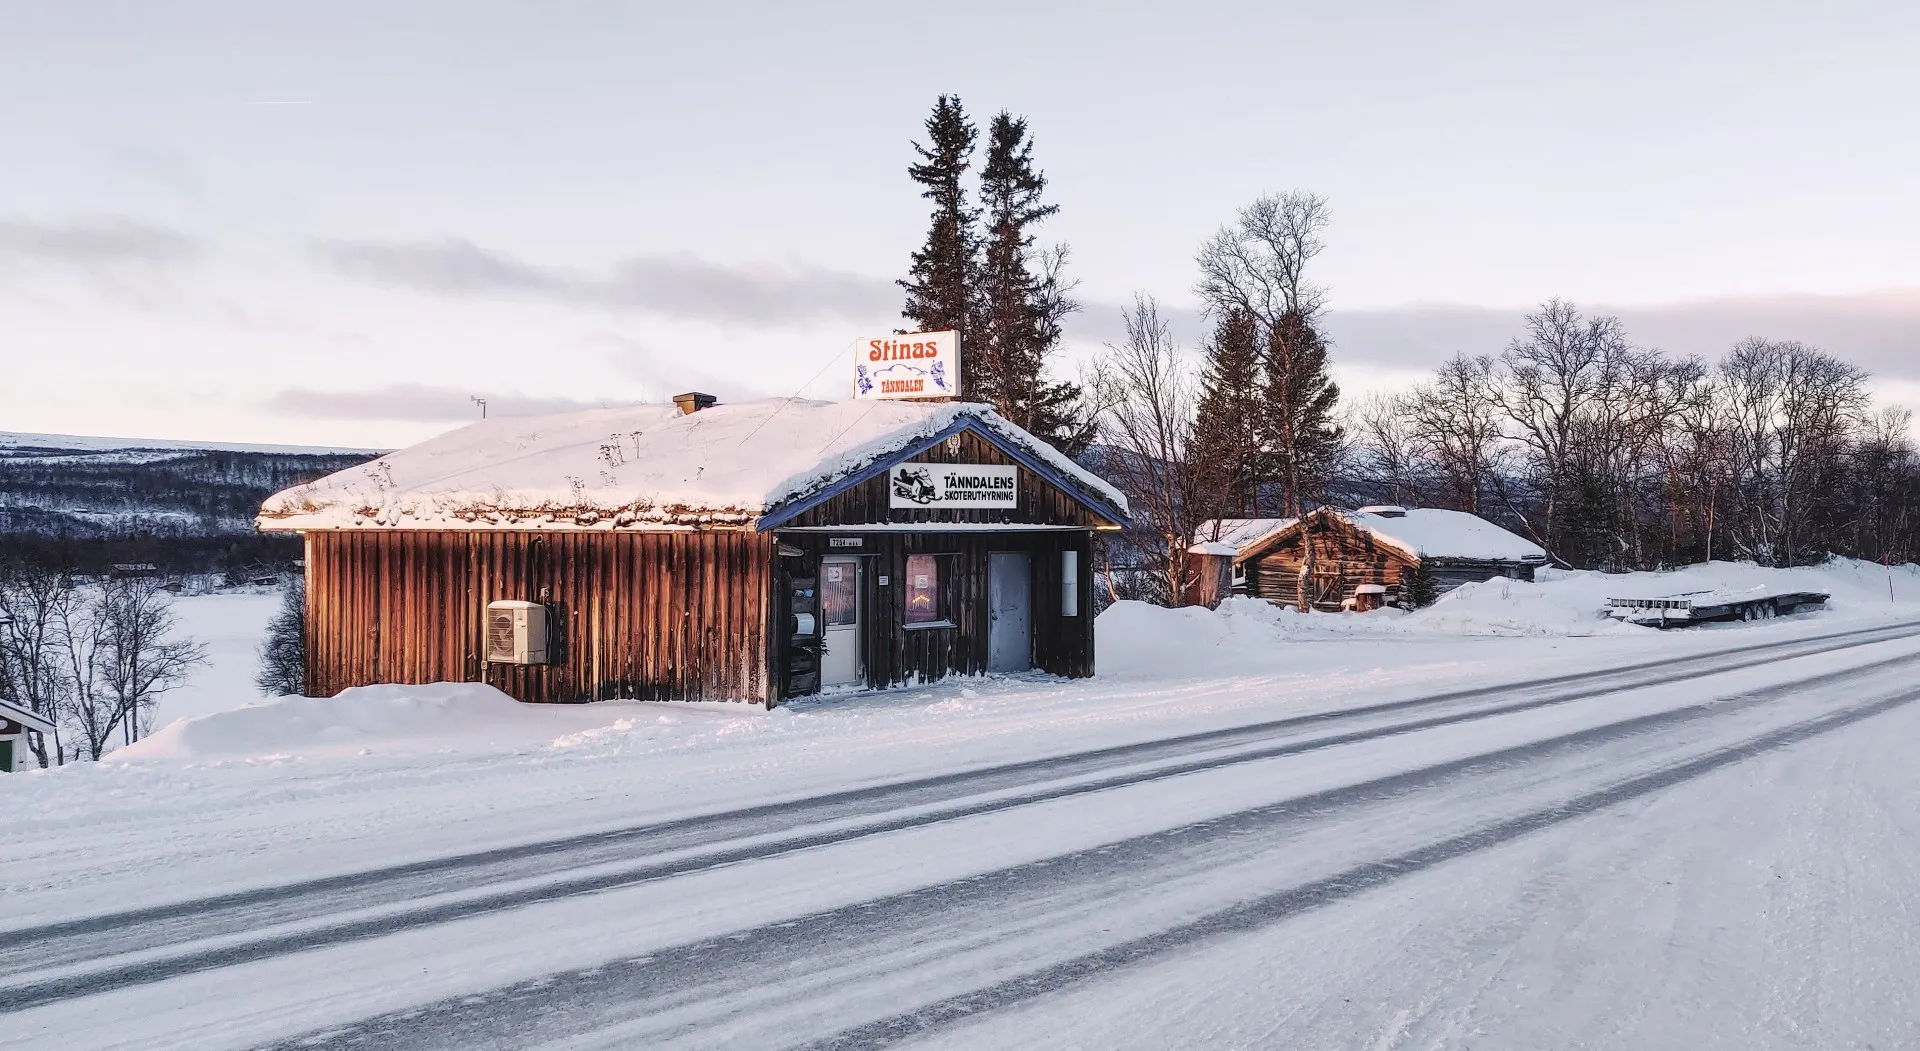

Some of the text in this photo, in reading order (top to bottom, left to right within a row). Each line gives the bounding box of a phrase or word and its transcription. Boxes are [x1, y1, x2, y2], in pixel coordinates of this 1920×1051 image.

[869, 340, 938, 362] Stinas
[881, 379, 924, 394] TÄNNDALEN
[944, 472, 1014, 490] TÄNNDALENS
[944, 490, 1014, 501] SKOTERUTHYRNING
